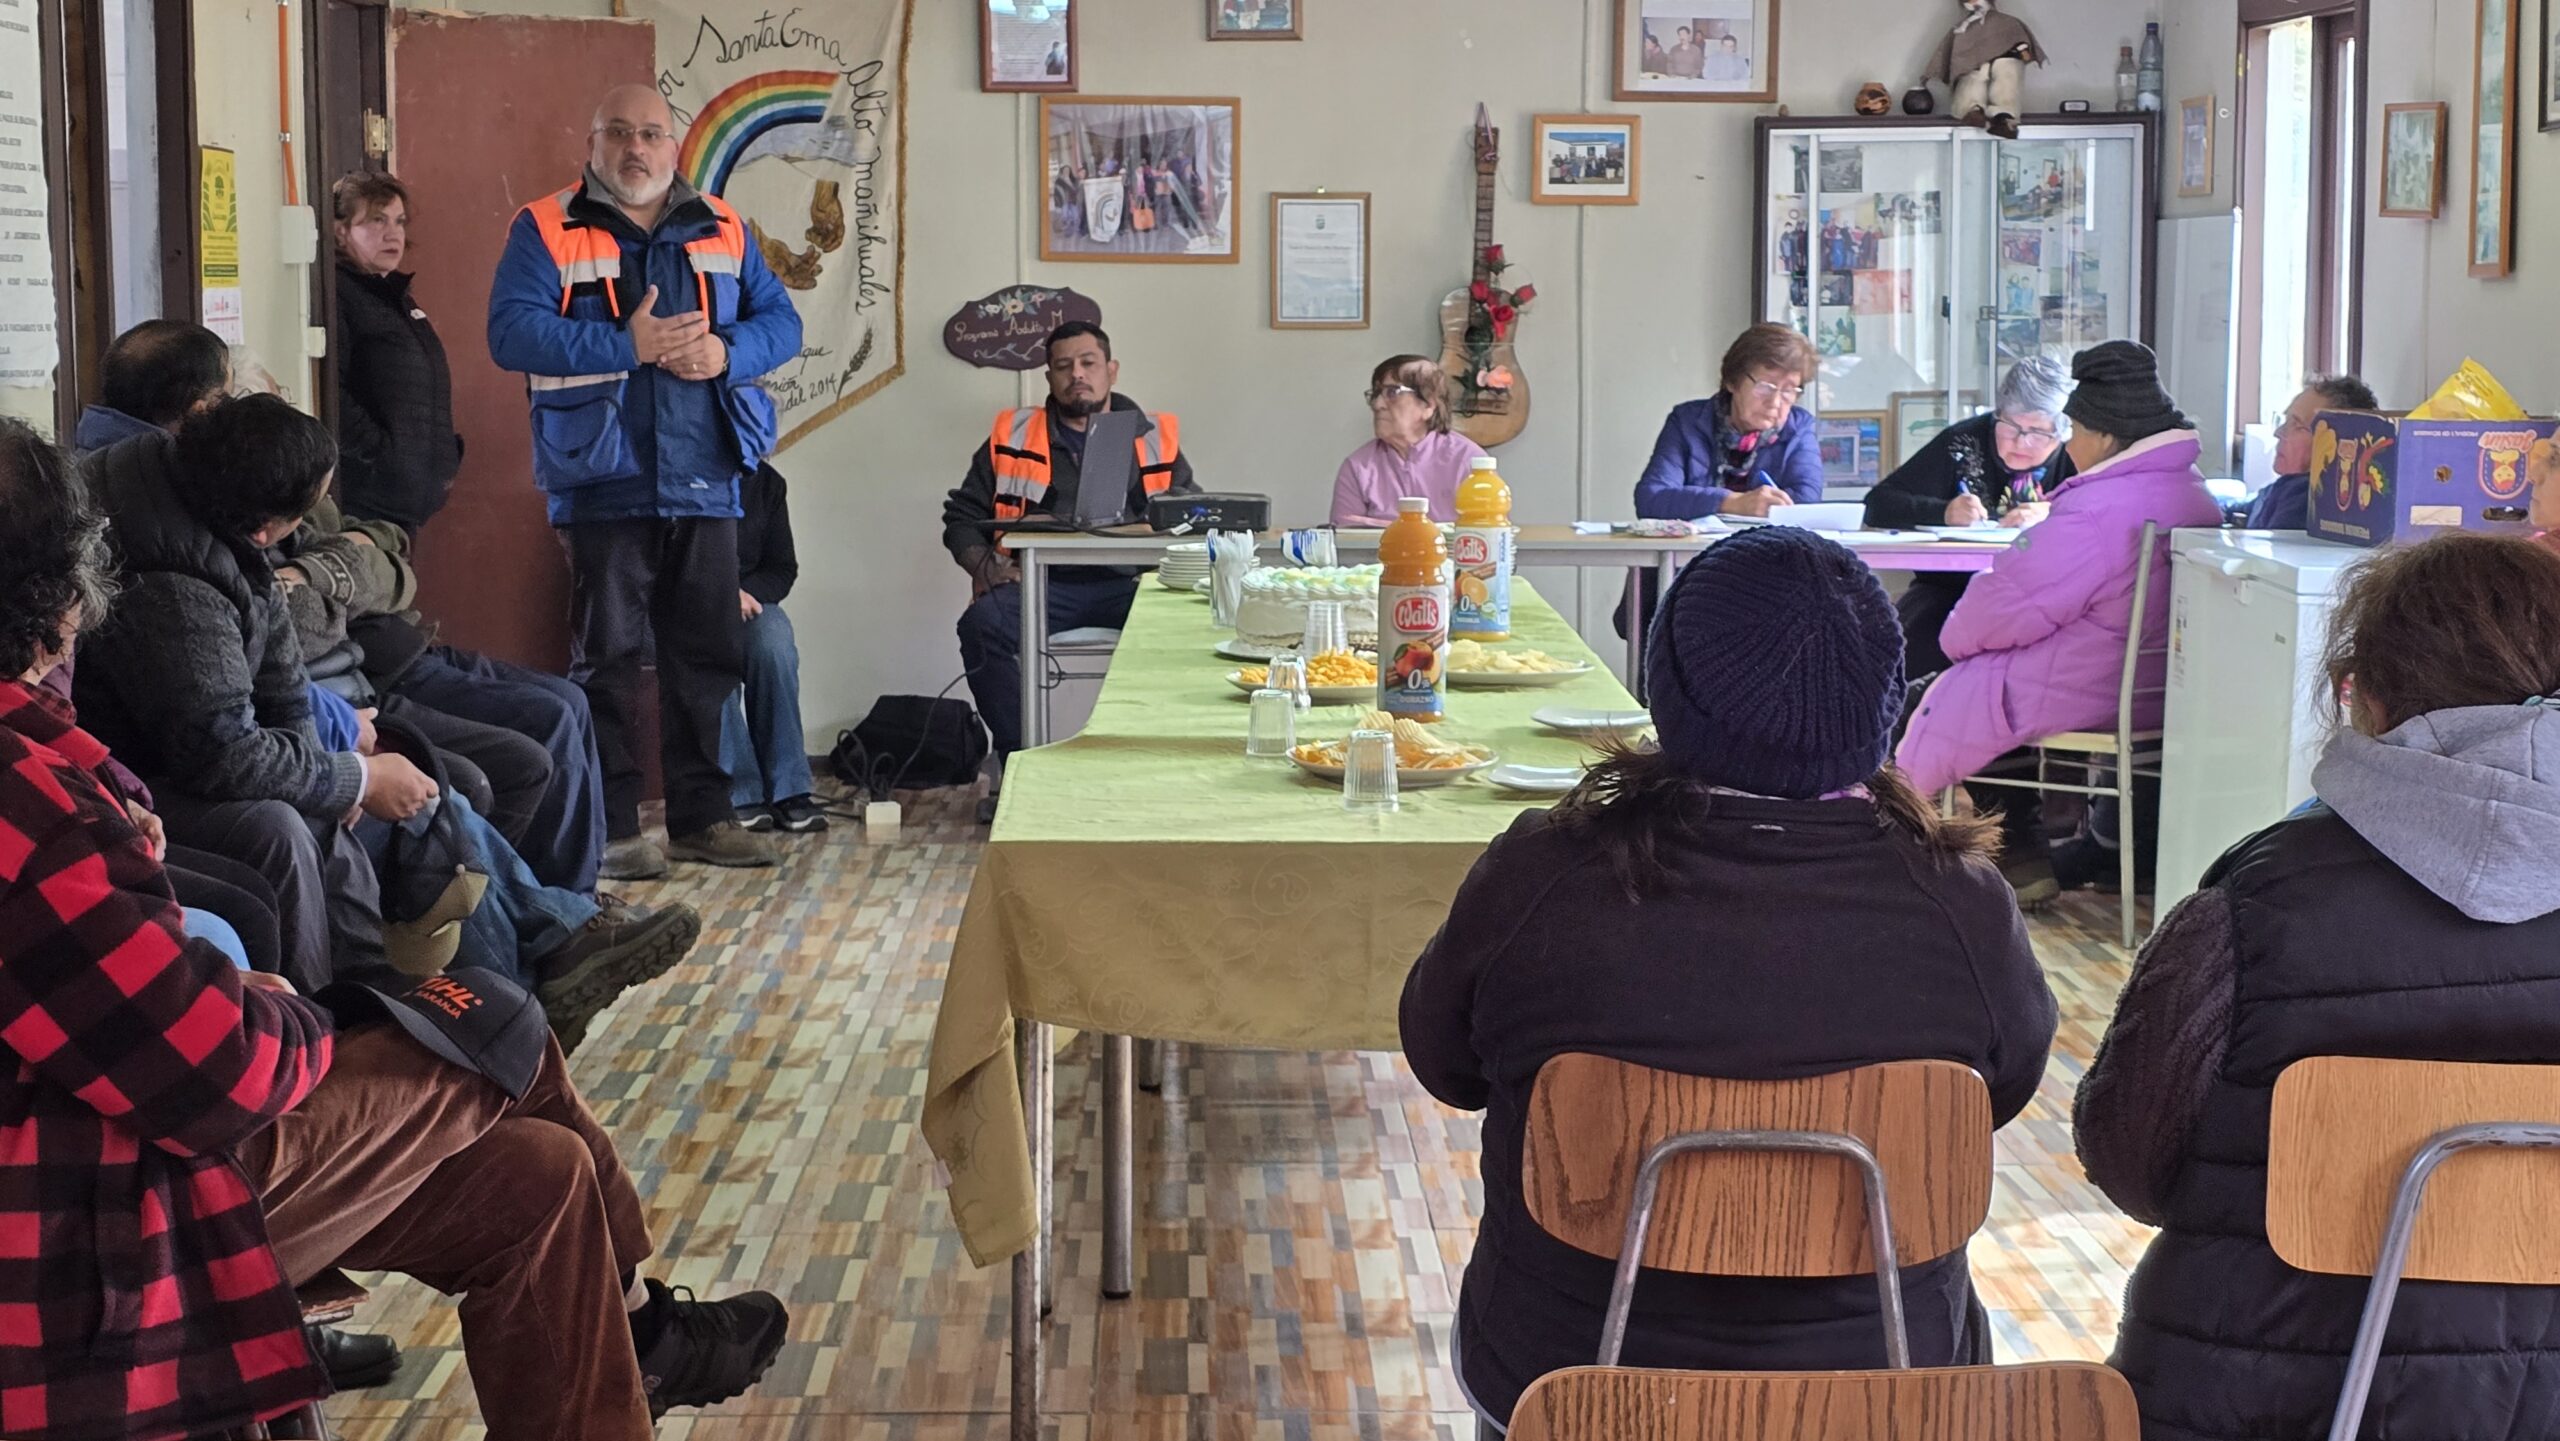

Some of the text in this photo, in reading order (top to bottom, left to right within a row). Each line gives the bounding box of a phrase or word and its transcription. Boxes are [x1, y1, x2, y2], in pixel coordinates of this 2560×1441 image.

[682, 10, 779, 68] Santa
[780, 8, 847, 67] Ema
[954, 321, 999, 342] Programa
[810, 373, 837, 400] 2014
